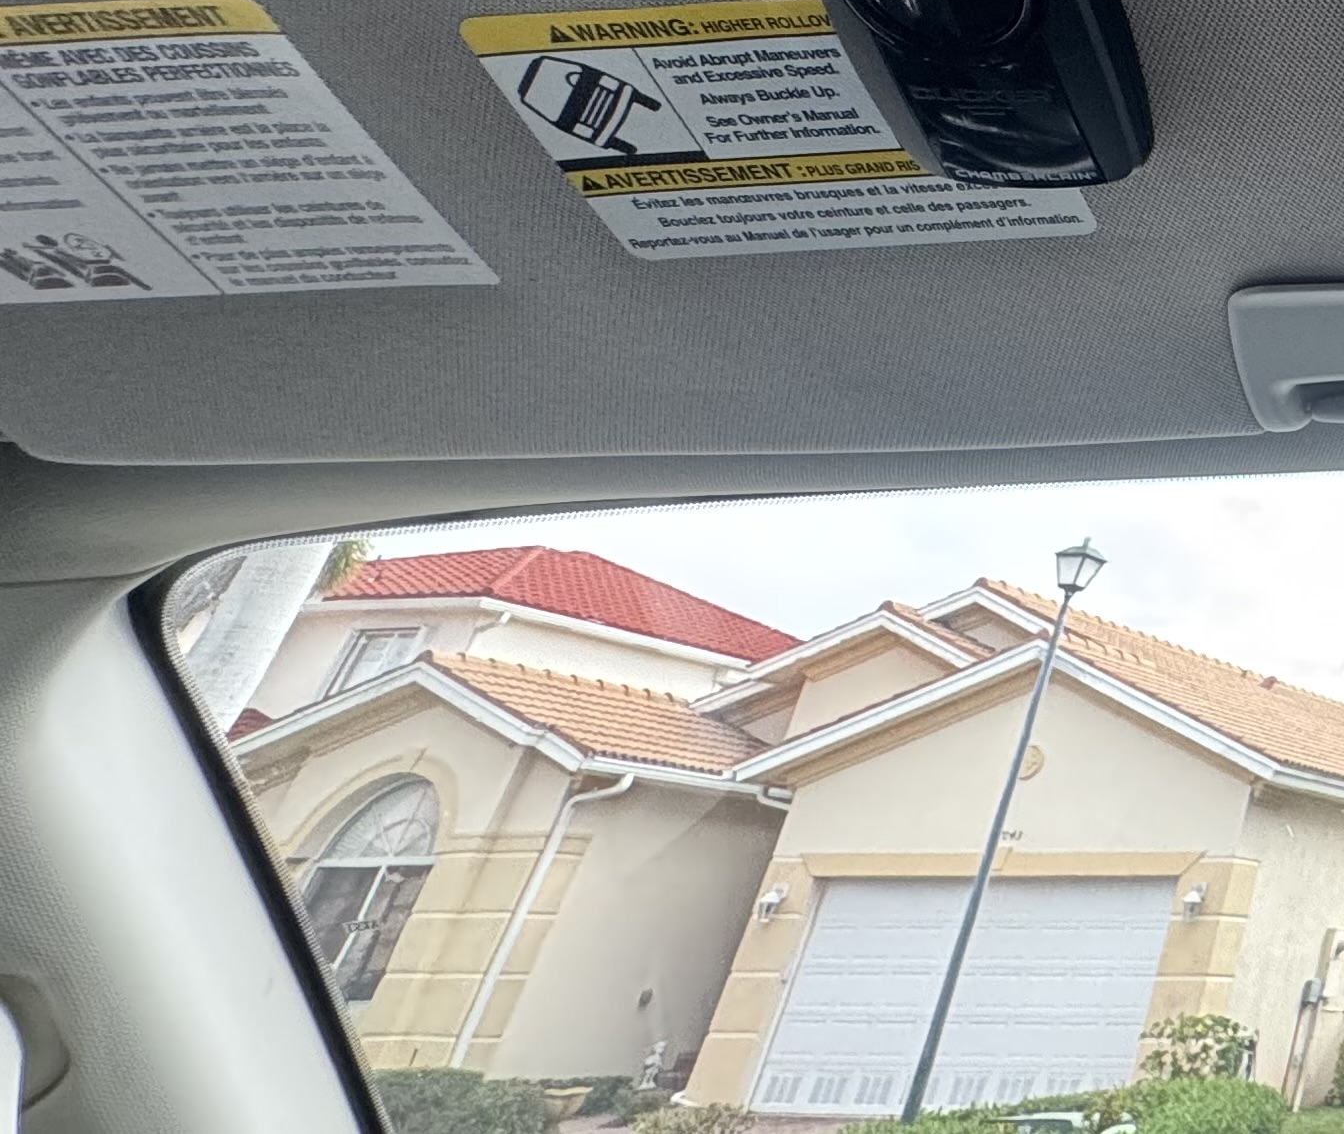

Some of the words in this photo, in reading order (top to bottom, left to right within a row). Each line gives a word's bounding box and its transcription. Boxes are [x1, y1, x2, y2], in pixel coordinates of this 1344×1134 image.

[6, 5, 229, 36] AVERTISSEMENT
[569, 18, 699, 42] WARNING:
[702, 17, 765, 35] HIGHER
[58, 47, 116, 66] AVEC
[111, 45, 160, 63] DES
[652, 56, 698, 70] Avoid
[699, 52, 752, 70] Abrupt
[755, 47, 842, 64] Maneuvers
[673, 72, 701, 86] and
[706, 68, 784, 84] Excessive
[786, 63, 841, 79] Speed.
[700, 90, 756, 106] Always
[758, 87, 810, 103] Buckle
[811, 86, 841, 102] Up.
[706, 115, 738, 129] See
[740, 112, 802, 127] Owner's
[805, 107, 860, 123] Manual
[705, 131, 732, 145] For
[734, 127, 790, 143] Further
[792, 120, 881, 140] Information.
[604, 163, 794, 190] AVERTISSEMENT
[808, 163, 844, 179] PLUS
[845, 161, 895, 176] GRAND
[631, 196, 678, 211] Évitez
[681, 195, 704, 207] les
[706, 191, 793, 207] manœuvres
[794, 187, 865, 202] brusques
[866, 185, 882, 196] et
[883, 183, 899, 195] la
[901, 181, 954, 194] vitesse
[657, 215, 715, 229] Bouclez
[717, 211, 781, 227] toujours
[783, 209, 816, 221] votre
[817, 205, 874, 220] ceinture
[876, 204, 891, 216] et
[892, 202, 926, 215] celle
[928, 201, 955, 213] des
[956, 197, 1033, 214] passagers.
[726, 233, 743, 243] au
[744, 227, 790, 242] Manuel
[791, 227, 809, 239] de
[811, 225, 862, 240] l'usager
[864, 224, 894, 237] pour
[899, 223, 915, 233] un
[916, 217, 994, 234] complément
